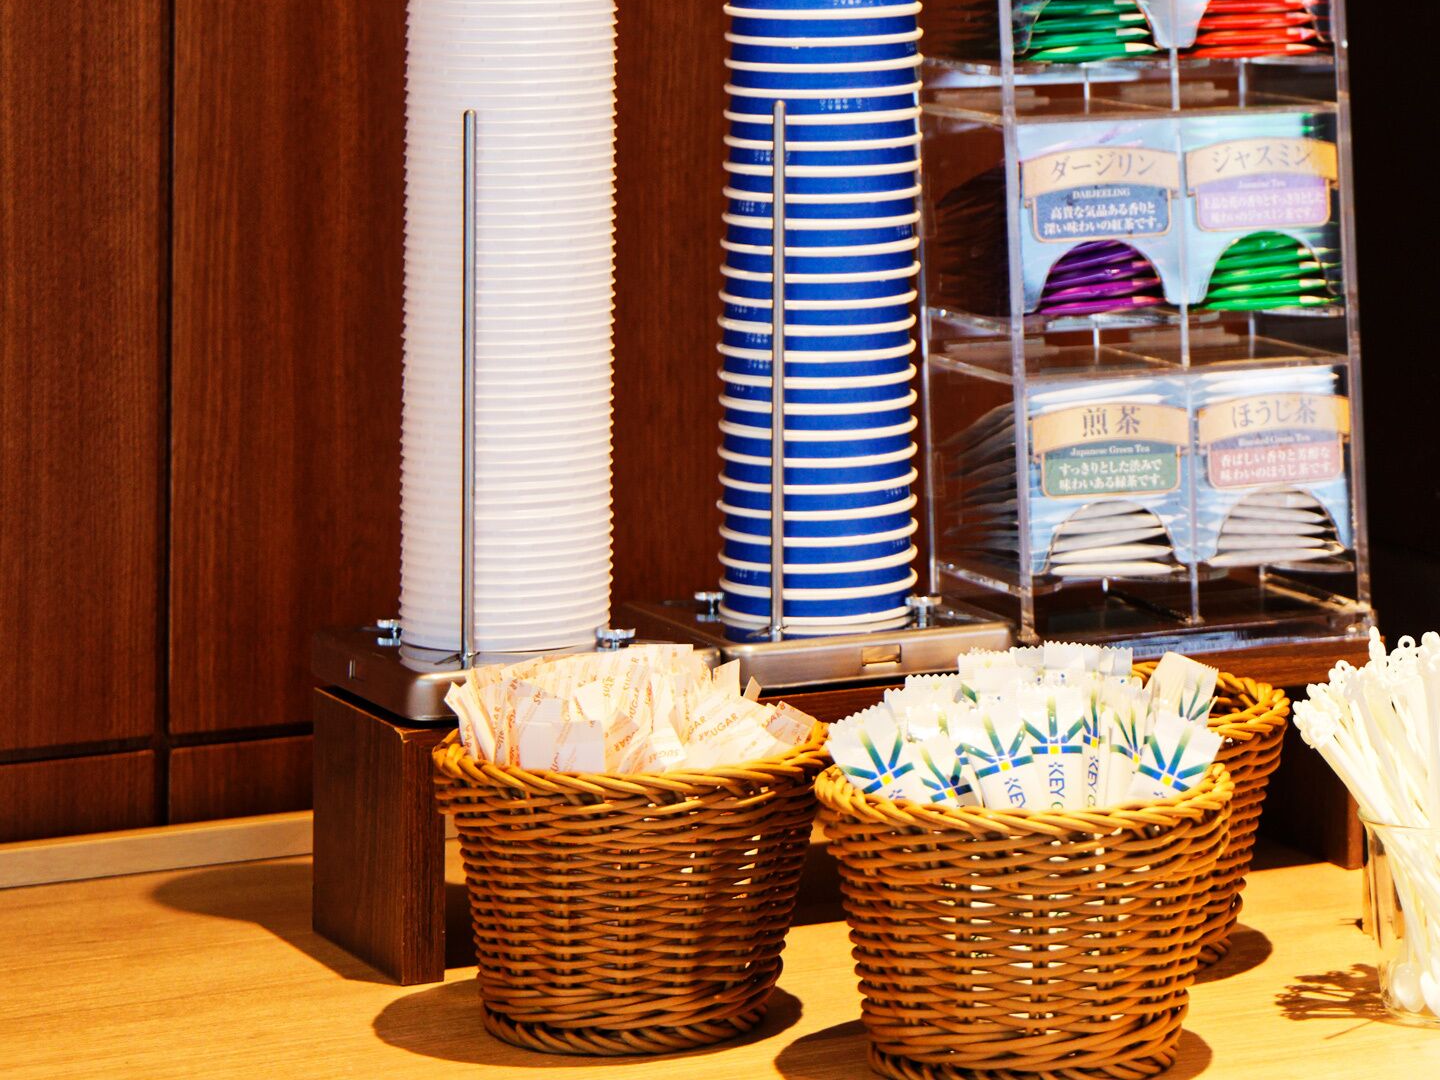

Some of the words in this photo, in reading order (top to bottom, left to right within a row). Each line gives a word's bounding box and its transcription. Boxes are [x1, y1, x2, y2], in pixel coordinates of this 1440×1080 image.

[1051, 151, 1155, 182] ダージリン
[1212, 143, 1312, 172] ジャスミン
[1072, 187, 1131, 199] DARJEELING
[1082, 406, 1141, 437] 煎茶
[1232, 397, 1317, 428] ほうじ茶
[1070, 447, 1107, 458] Japanese
[1109, 445, 1133, 454] Green
[1135, 444, 1150, 453] Tea
[1048, 762, 1065, 798] KEY
[1087, 756, 1099, 793] KEY
